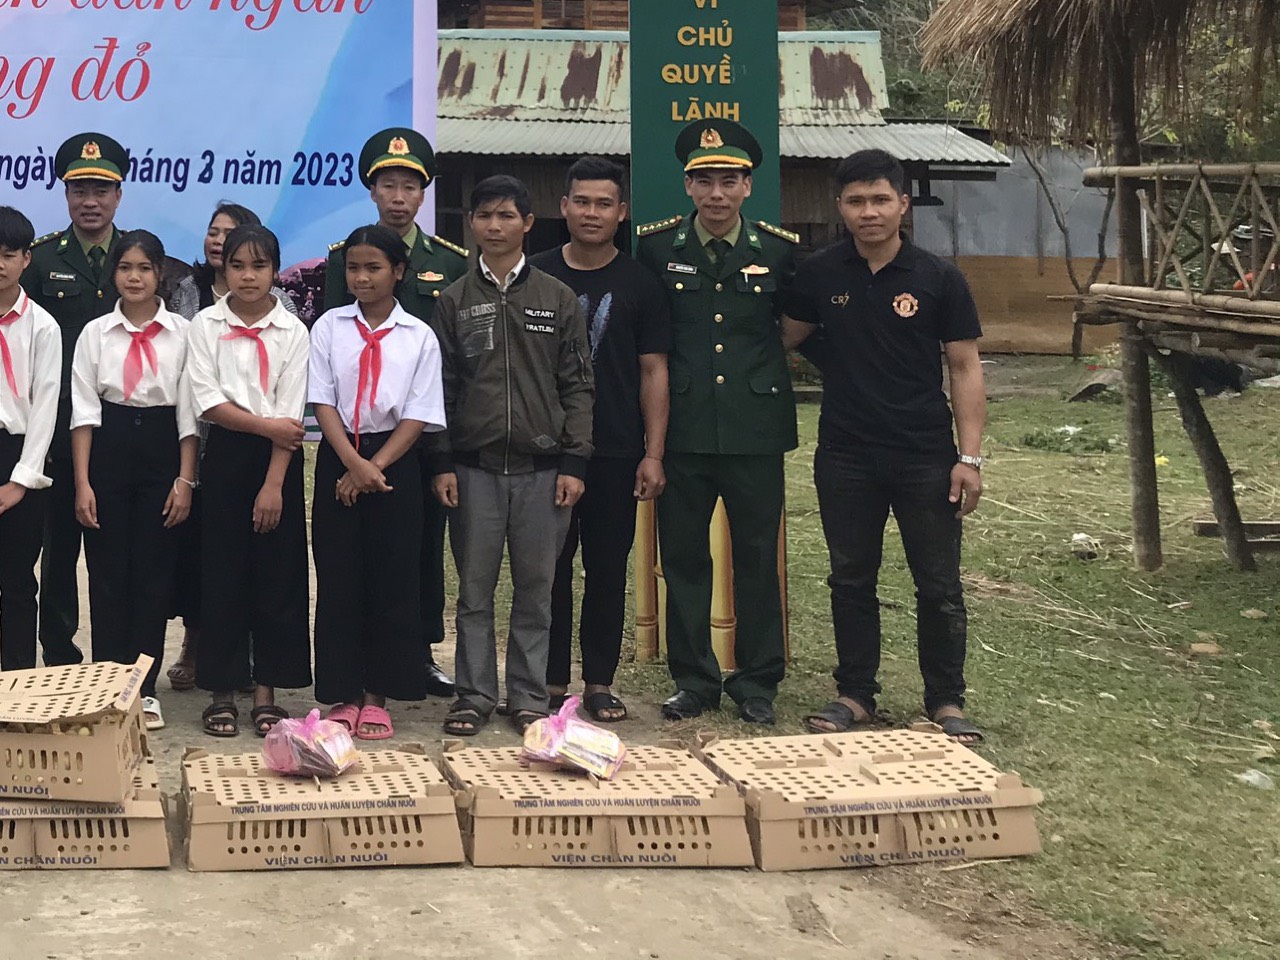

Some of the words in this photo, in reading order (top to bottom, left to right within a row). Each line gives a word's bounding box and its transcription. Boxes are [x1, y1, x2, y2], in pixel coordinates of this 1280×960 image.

[677, 19, 733, 47] CHỦ
[71, 37, 153, 101] đỏ
[671, 96, 740, 121] LÃNH
[122, 148, 190, 192] háng
[222, 150, 282, 185] năm
[291, 151, 354, 186] 2023
[831, 290, 850, 308] CR7
[525, 308, 555, 318] MILITARY
[12, 784, 49, 796] NUÔI
[230, 805, 255, 815] TRUNG
[256, 804, 272, 814] TÂM
[273, 803, 300, 813] NGHIÊN
[398, 799, 416, 808] NUÔI
[514, 800, 538, 808] TRUNG
[539, 799, 555, 807] TÂM
[556, 798, 583, 807] NGHIÊN
[682, 798, 701, 807] NUÔI
[108, 805, 126, 815] NUÔI
[350, 853, 388, 863] NUÔI
[638, 852, 677, 863] NUÔI
[927, 847, 966, 858] NUÔI
[58, 855, 98, 865] NUÔI
